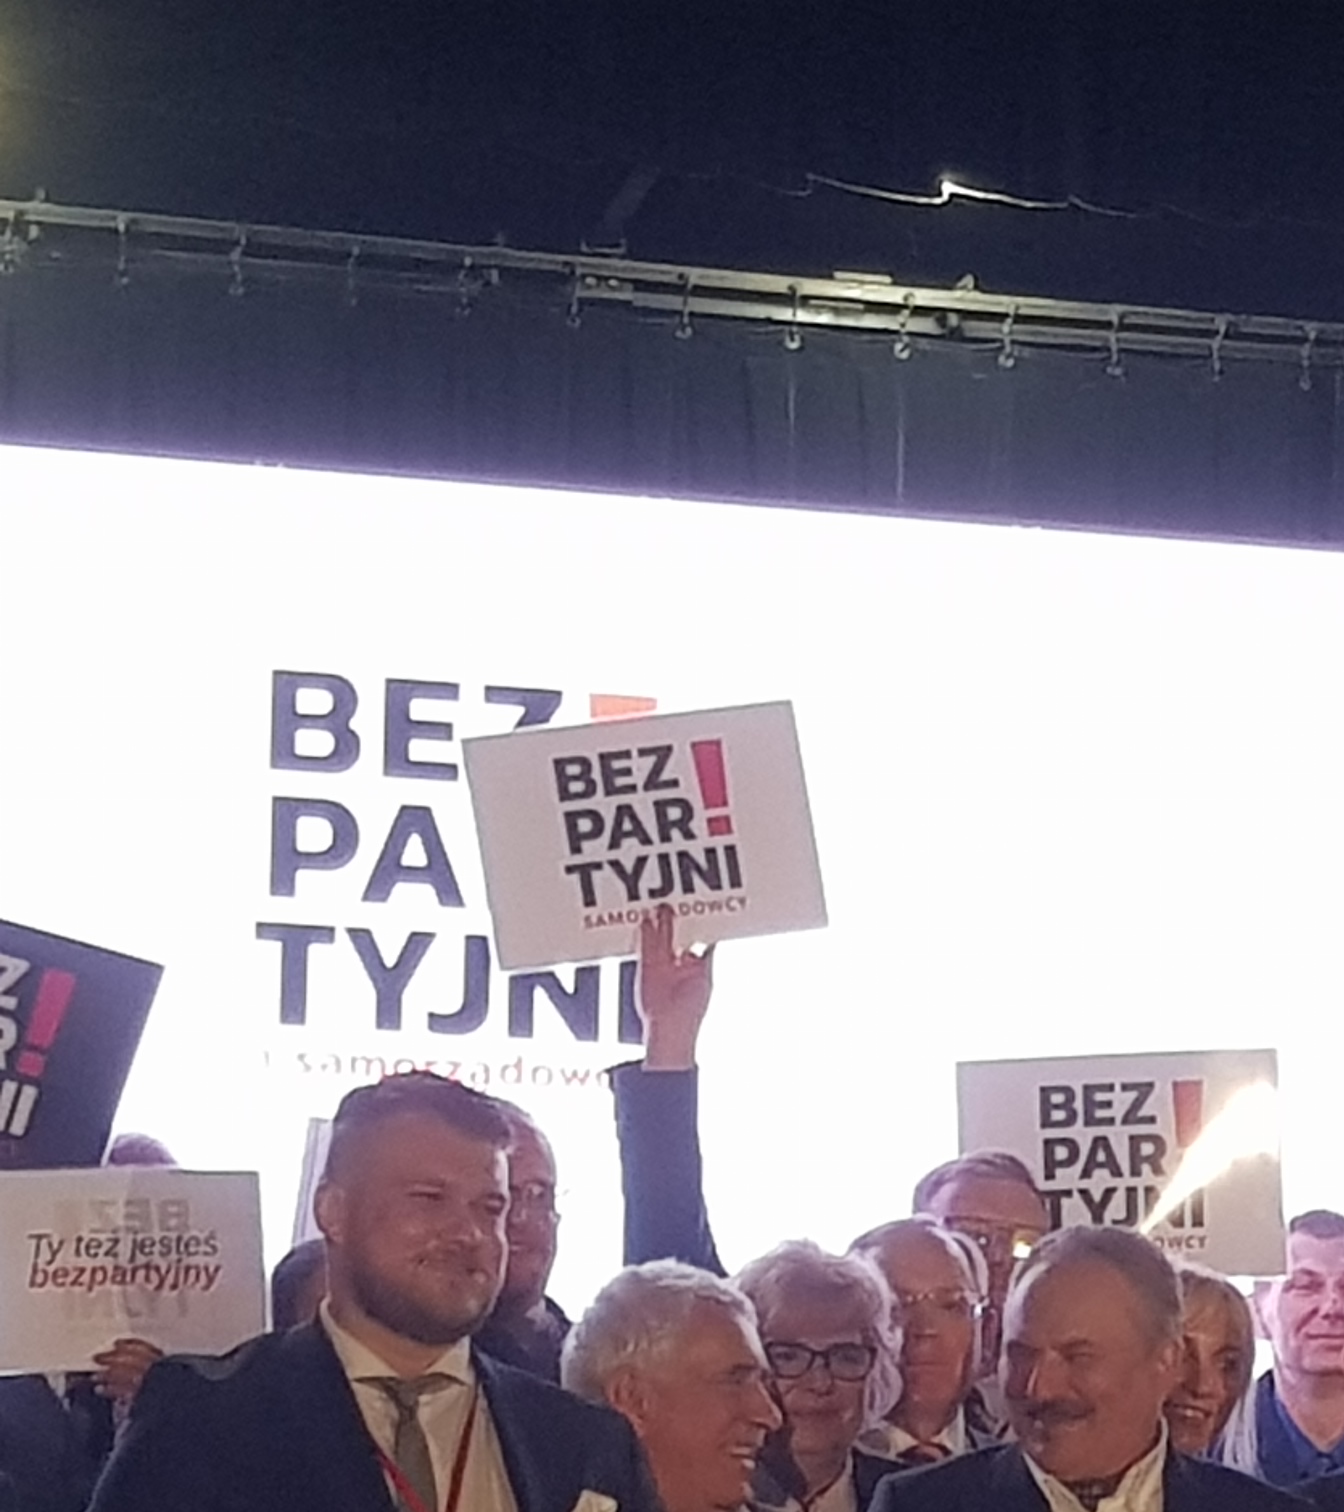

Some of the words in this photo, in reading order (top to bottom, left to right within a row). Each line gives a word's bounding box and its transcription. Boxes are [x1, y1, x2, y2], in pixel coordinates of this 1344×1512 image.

[551, 745, 680, 803] BEZ
[270, 796, 466, 907] PA
[563, 798, 696, 856] PAR
[564, 844, 744, 908] TYJNI
[256, 921, 645, 1045] TYJNI
[1038, 1081, 1158, 1131] BEZ
[1042, 1134, 1168, 1181] PAR
[27, 1233, 66, 1266] Ty
[28, 1258, 222, 1293] bezpartyjny
